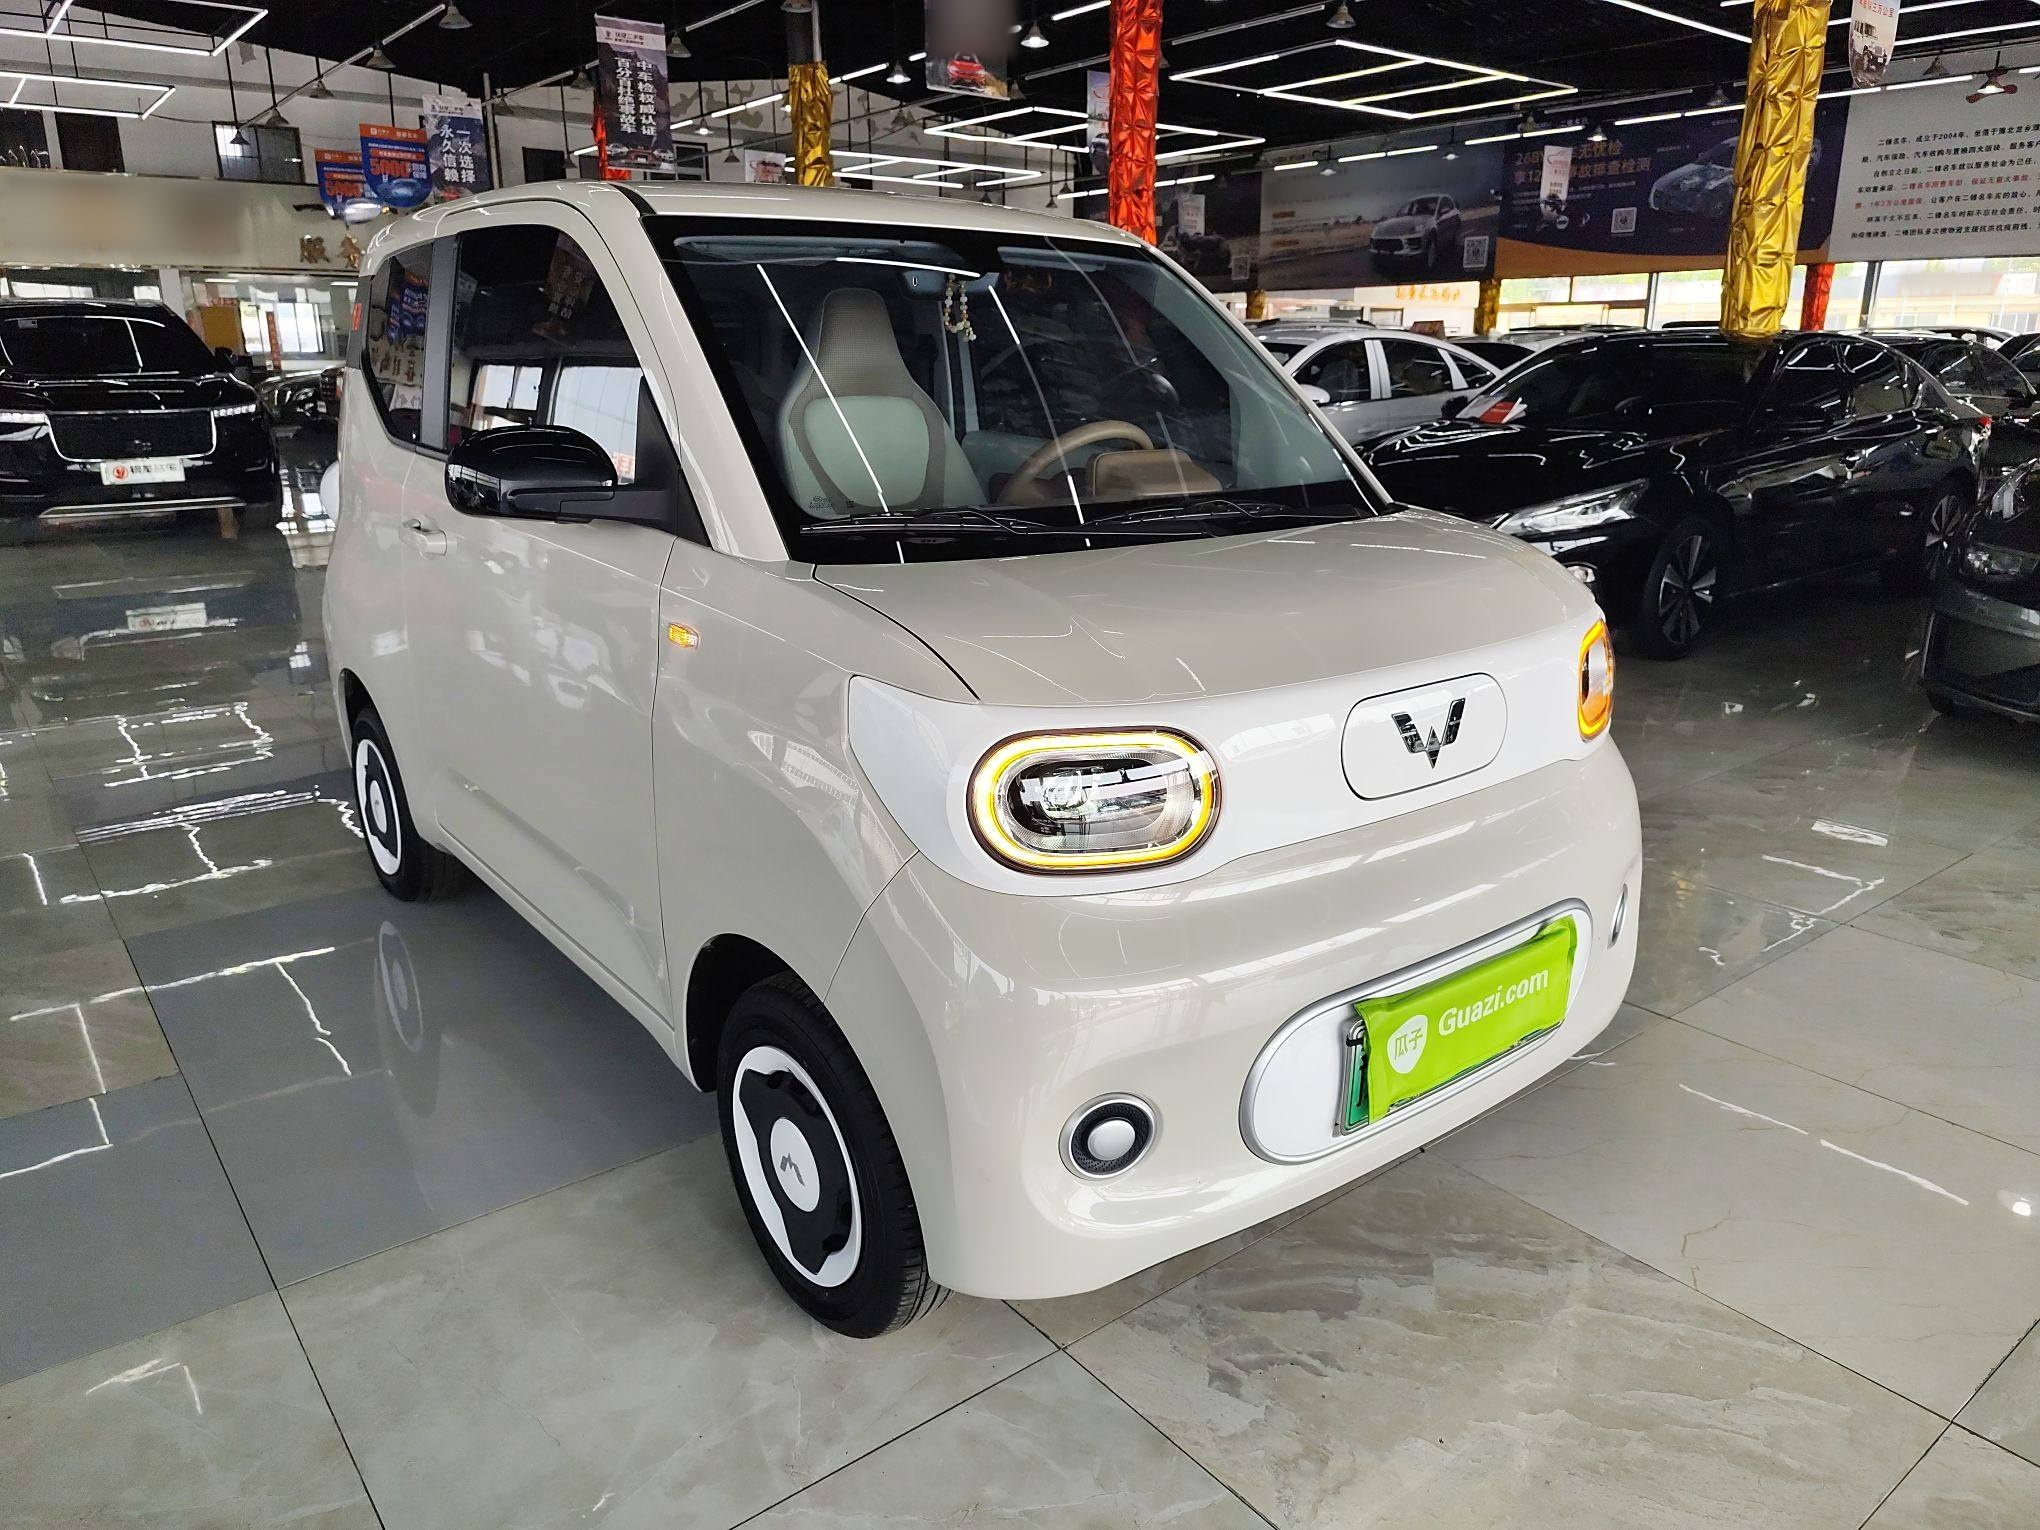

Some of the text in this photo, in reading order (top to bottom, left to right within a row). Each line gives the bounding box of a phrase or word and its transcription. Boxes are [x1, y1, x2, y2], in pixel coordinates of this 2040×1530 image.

[636, 59, 657, 136] 中车检权威认证
[440, 124, 459, 183] 永久信赖
[456, 129, 476, 183] 一次选择
[1438, 969, 1549, 1037] Guazi.com
[1393, 1027, 1424, 1062] 瓜子
